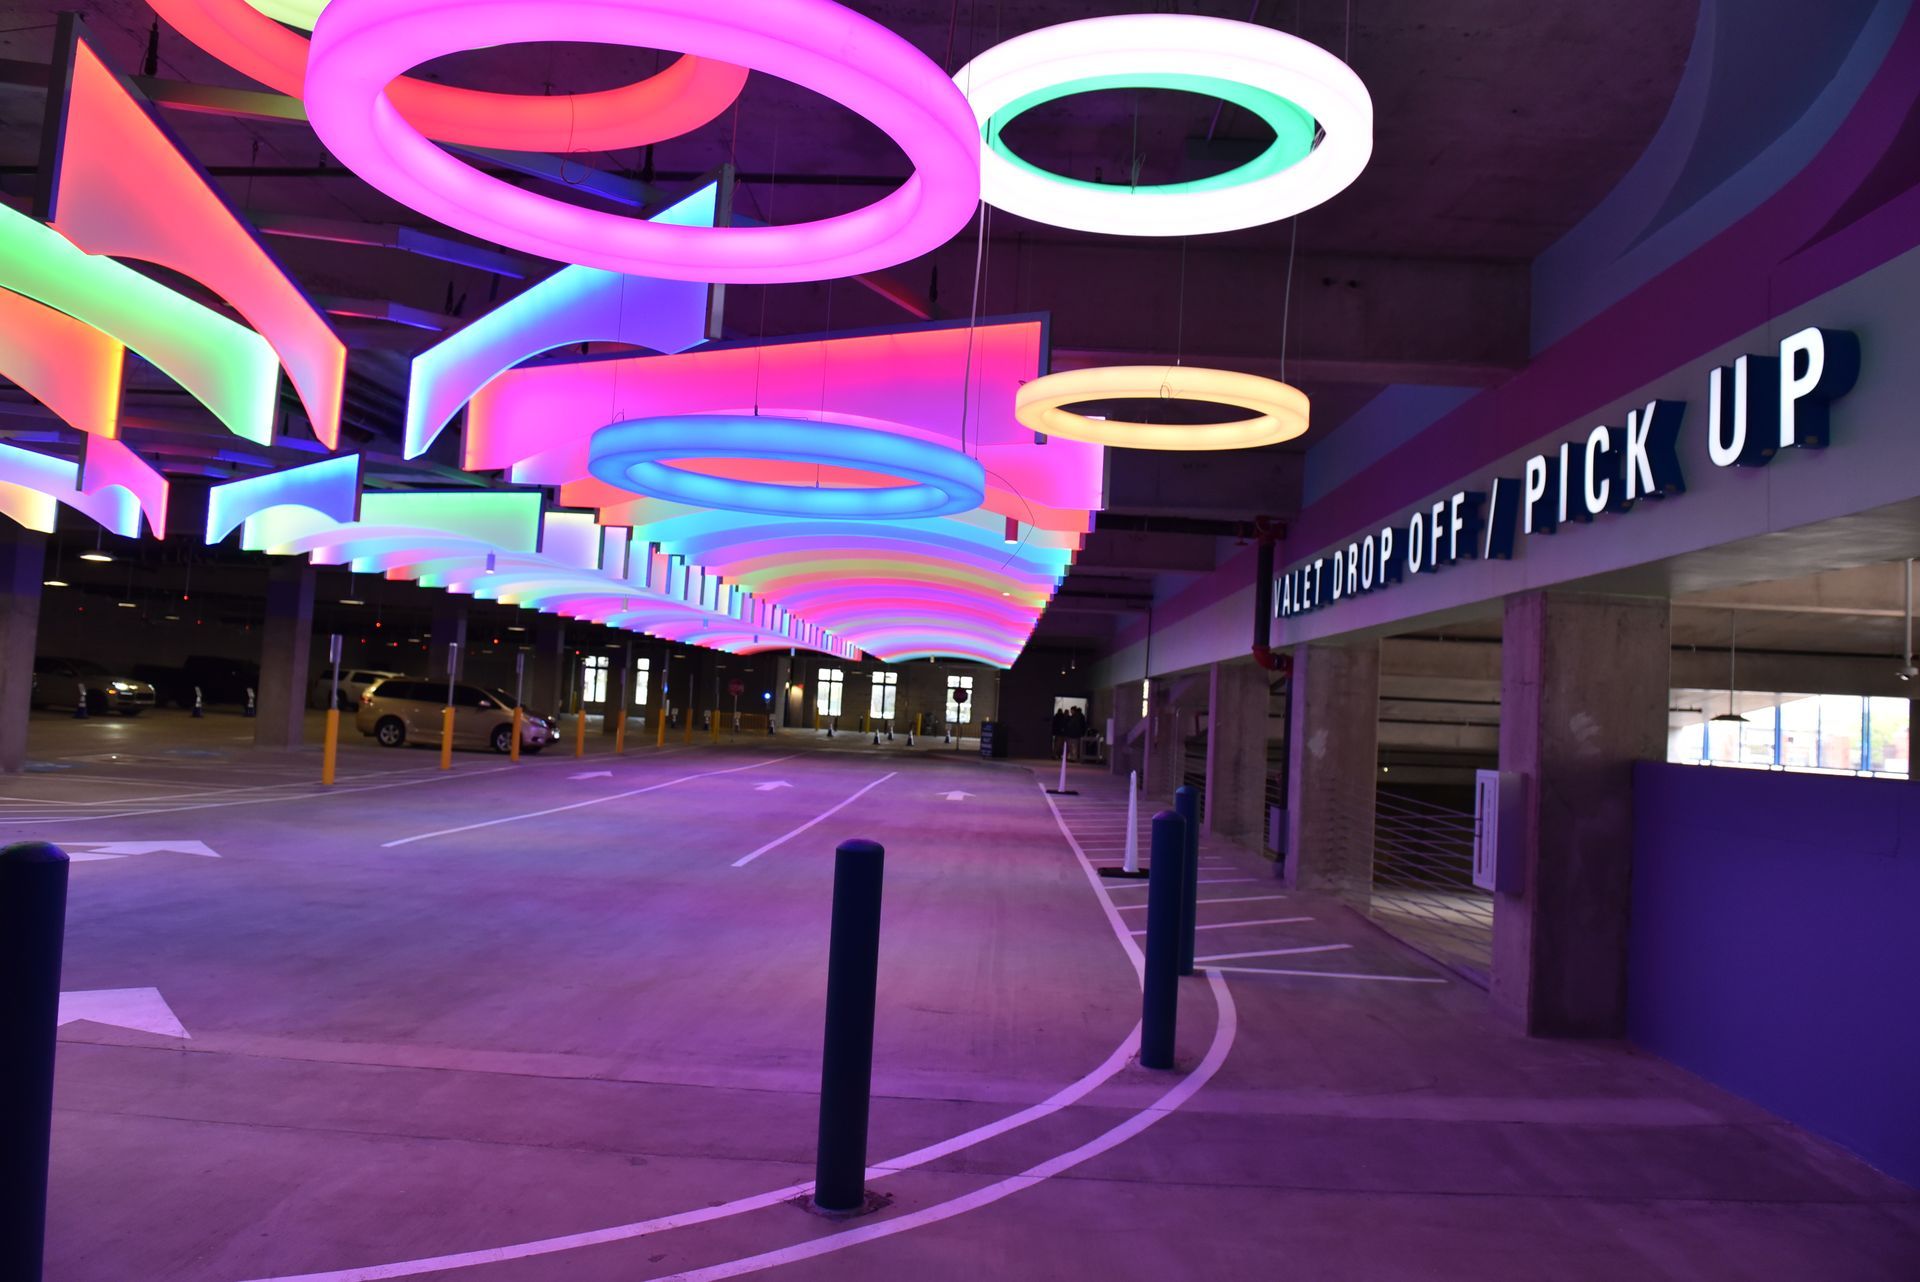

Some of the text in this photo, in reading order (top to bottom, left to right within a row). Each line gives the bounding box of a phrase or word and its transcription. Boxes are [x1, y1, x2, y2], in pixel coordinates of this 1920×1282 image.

[1274, 558, 1323, 618] VALET
[1333, 526, 1393, 600] DROP
[1408, 491, 1465, 574] OFF
[1524, 400, 1656, 534] PICK
[1708, 326, 1825, 467] UP
